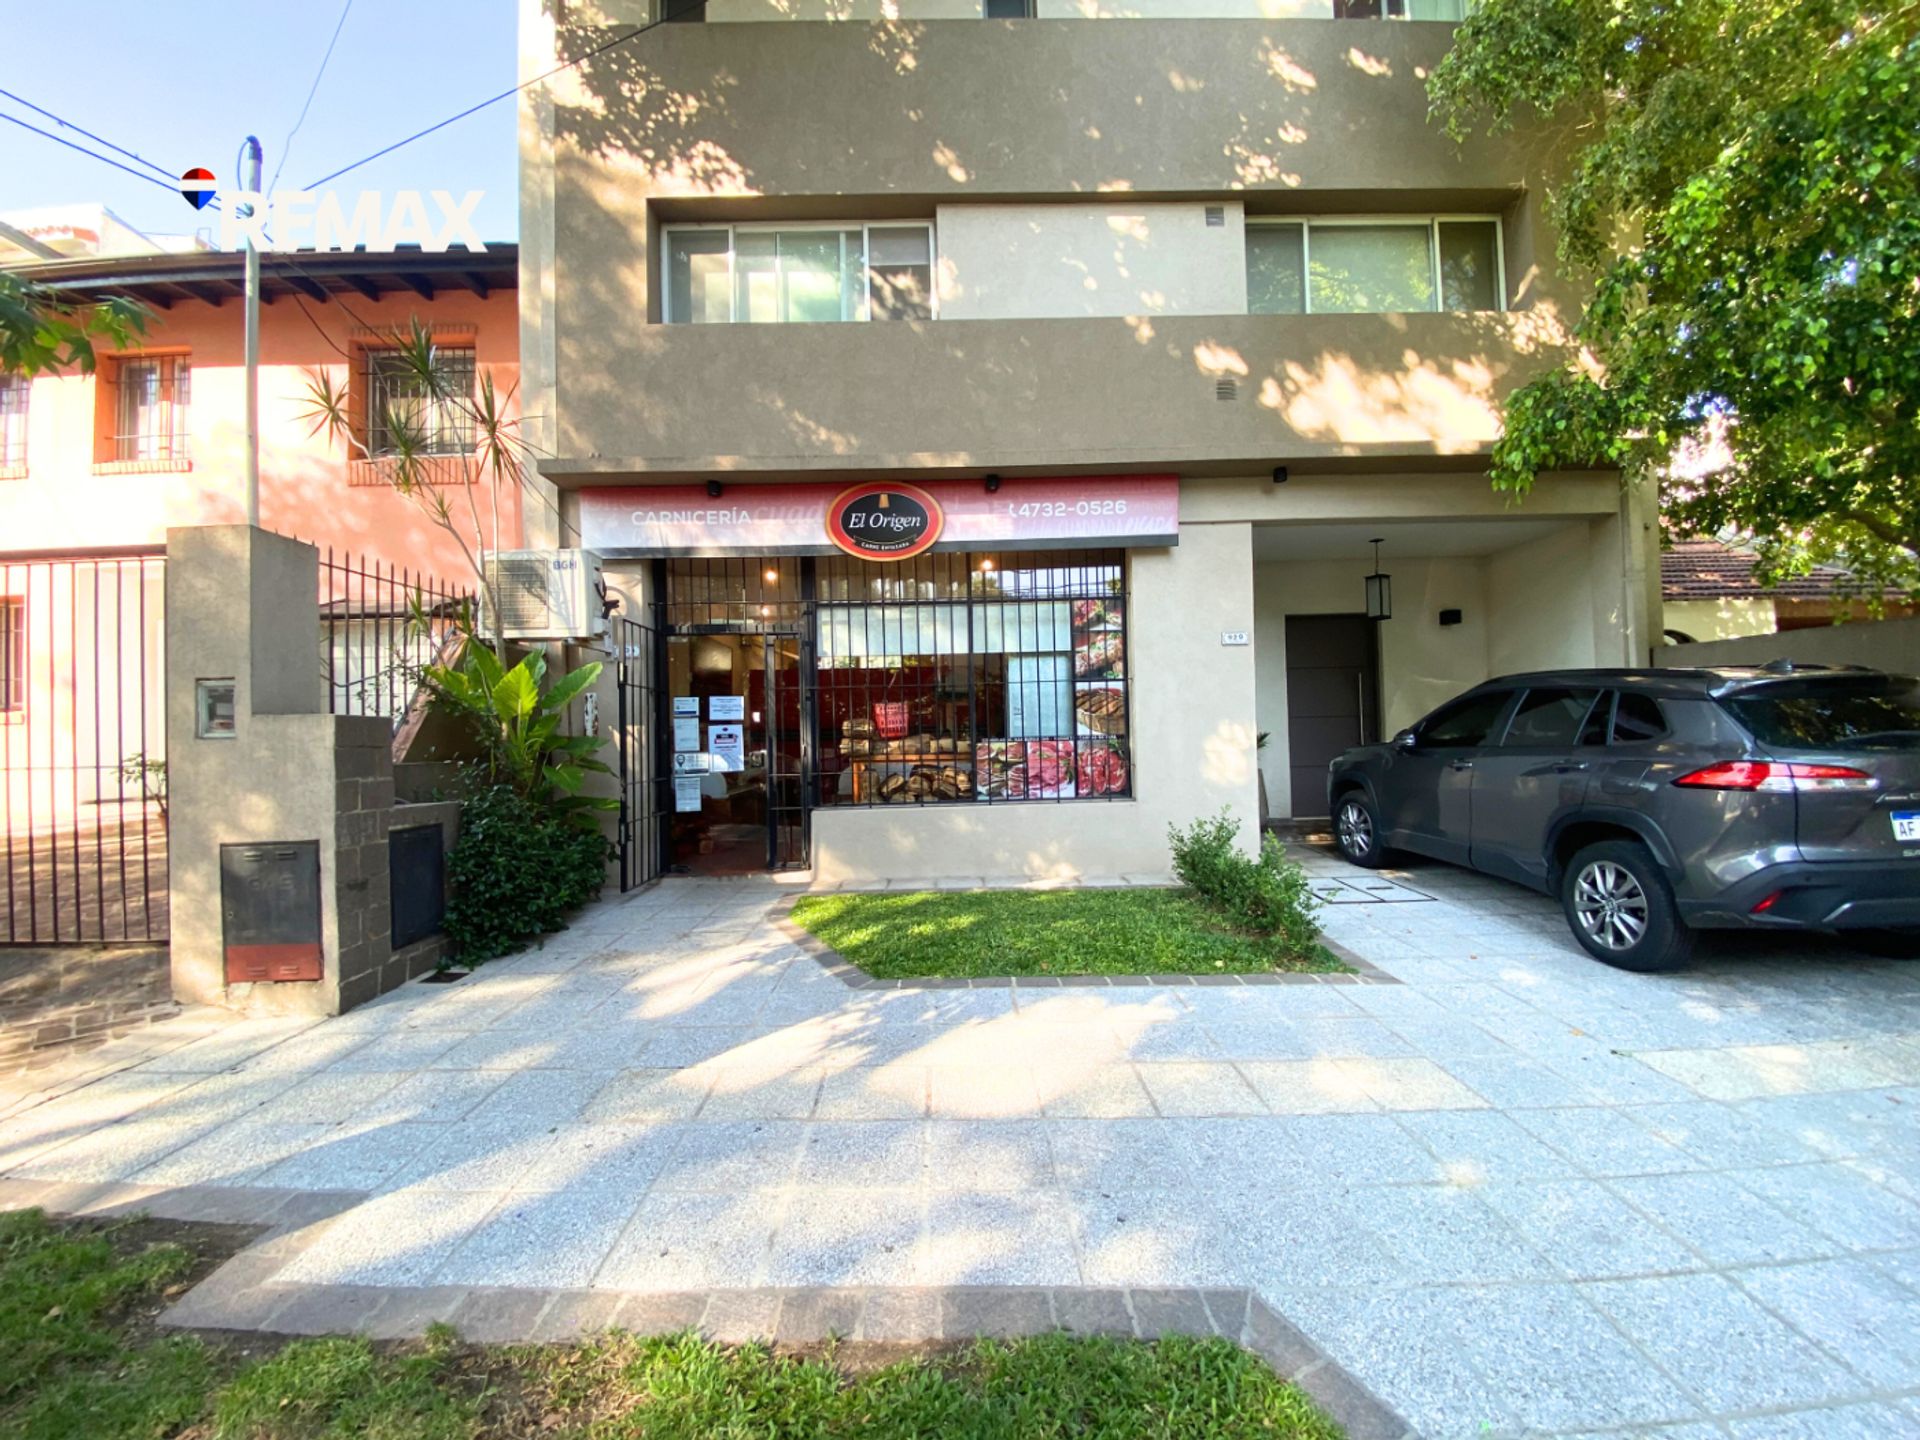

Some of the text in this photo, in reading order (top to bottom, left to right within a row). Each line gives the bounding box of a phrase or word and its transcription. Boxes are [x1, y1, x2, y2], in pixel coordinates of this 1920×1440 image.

[631, 507, 752, 526] CARNICERÍA
[1018, 500, 1128, 518] 4732-0526
[848, 512, 921, 532] El Origen
